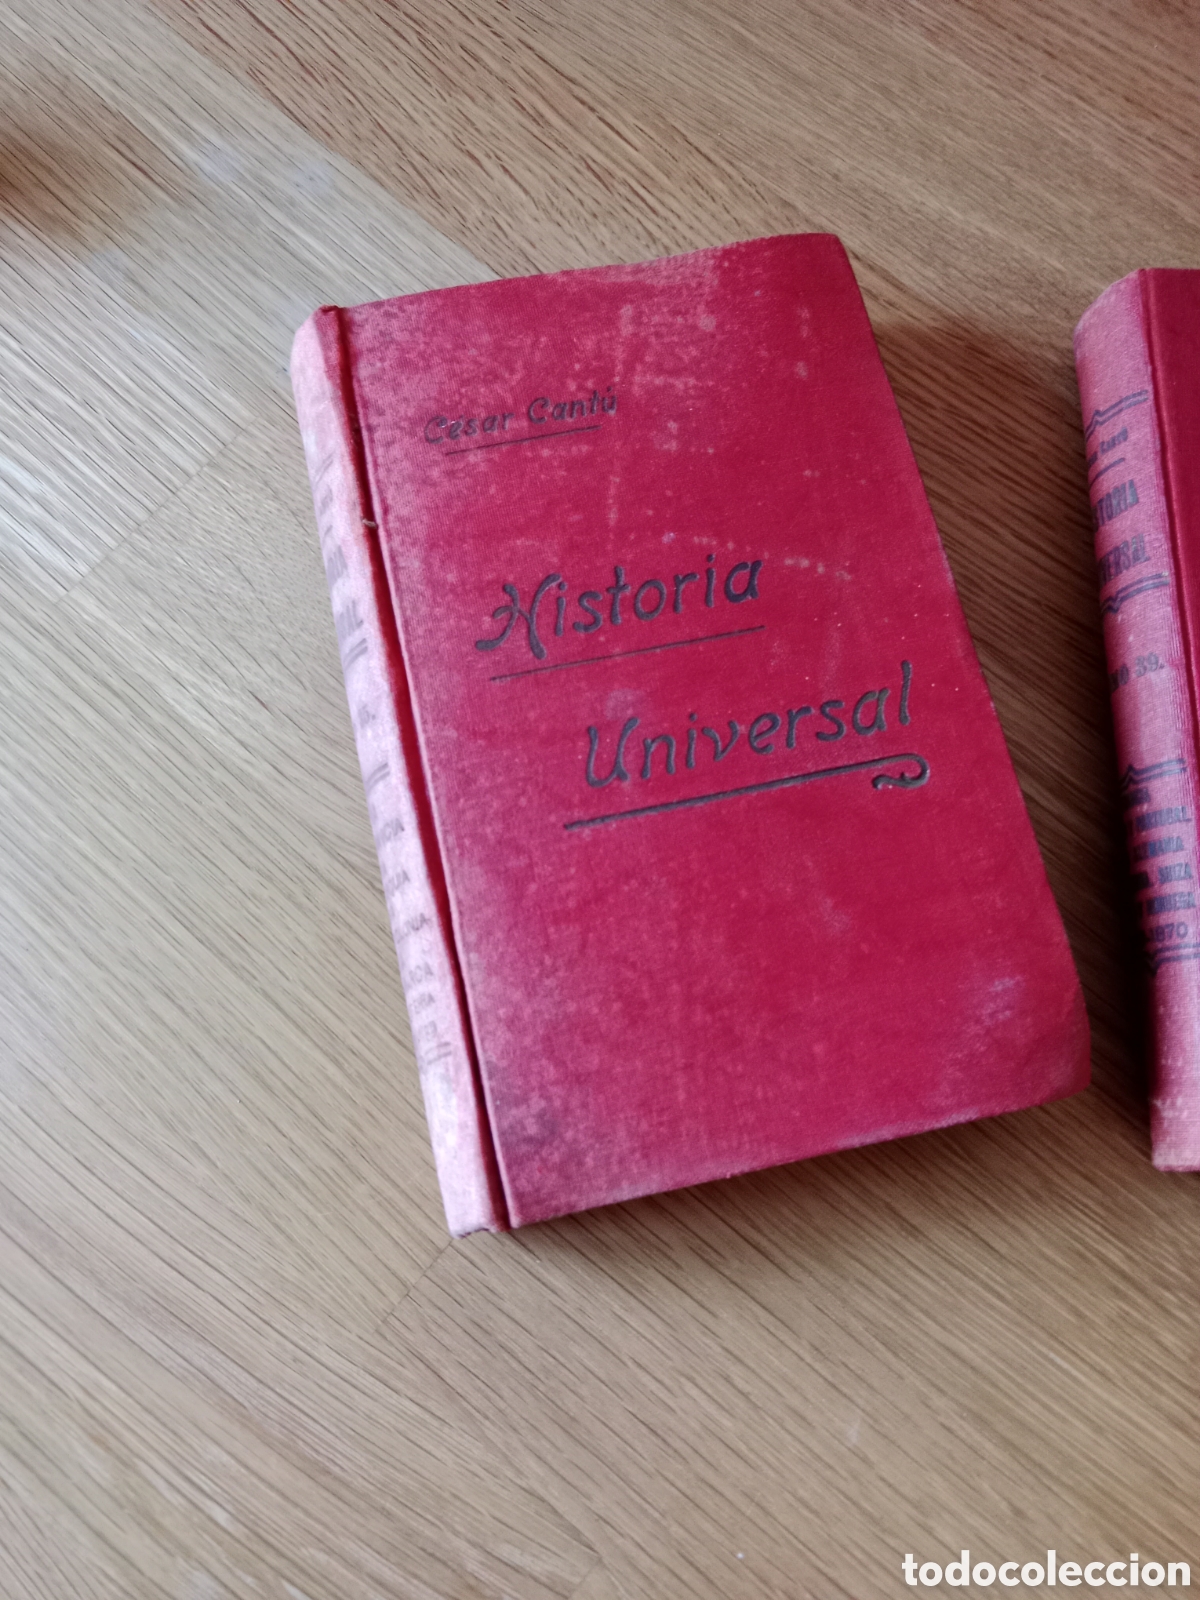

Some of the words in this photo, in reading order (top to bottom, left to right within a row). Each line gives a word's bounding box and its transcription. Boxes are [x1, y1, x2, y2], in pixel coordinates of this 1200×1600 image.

[528, 386, 617, 425] Cantú
[474, 554, 763, 660] Historia
[583, 660, 912, 788] Universal
